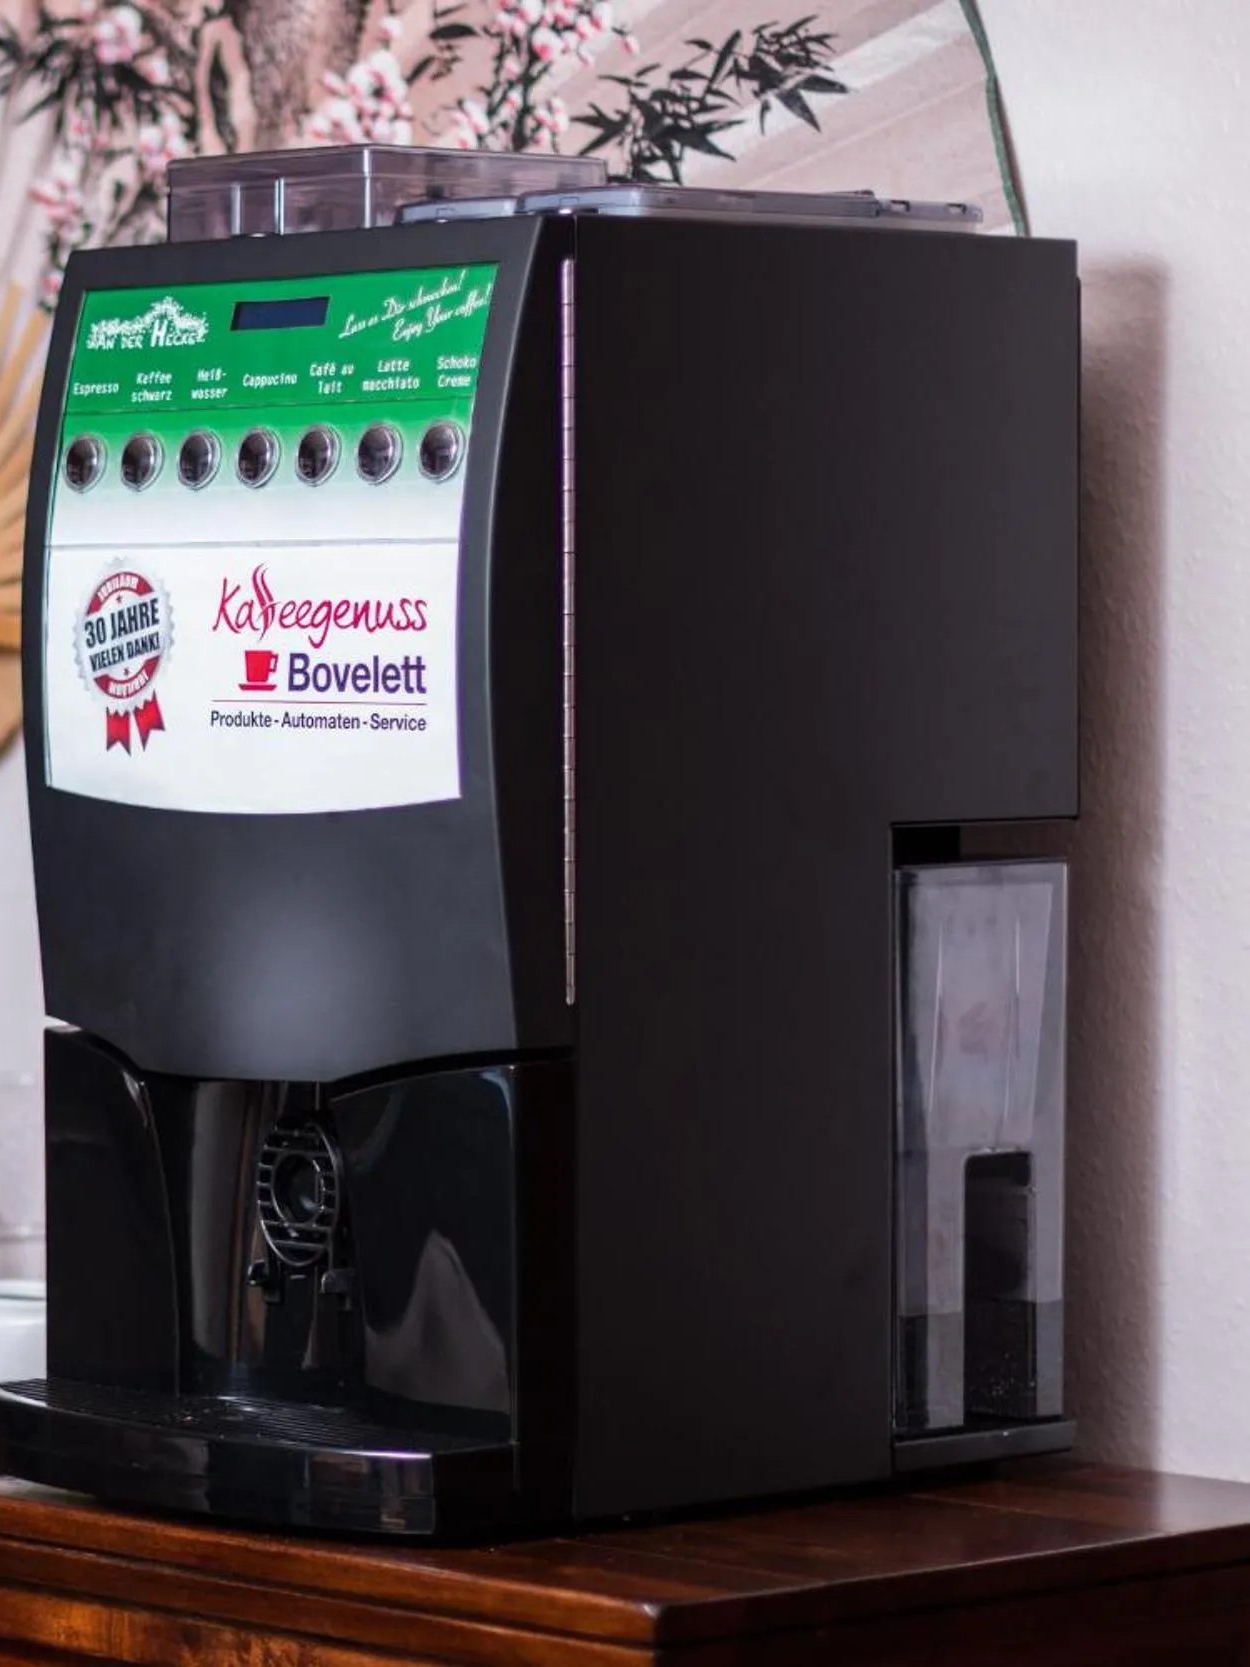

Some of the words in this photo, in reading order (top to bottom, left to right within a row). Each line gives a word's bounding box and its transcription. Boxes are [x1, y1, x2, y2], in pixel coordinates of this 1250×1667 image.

[392, 318, 422, 341] Enjoy
[342, 363, 354, 375] au
[377, 359, 410, 373] Latte
[437, 355, 477, 371] Schoko
[137, 372, 172, 385] Kaffee
[243, 373, 298, 389] Cappucino
[362, 376, 420, 392] macchiato
[437, 374, 471, 388] Creme
[73, 383, 119, 397] Espresso
[191, 387, 228, 400] wasser
[318, 380, 342, 394] lait
[131, 389, 172, 403] schwarz
[212, 563, 428, 649] Kaffeegenuss
[84, 617, 106, 649] 30
[111, 598, 160, 641] JAHRE
[89, 643, 124, 673] VIELEN
[127, 632, 160, 658] DANK!
[288, 652, 427, 694] Bovelett
[211, 710, 272, 729] Produkte
[281, 711, 361, 730] Automaten
[370, 713, 427, 731] Service
